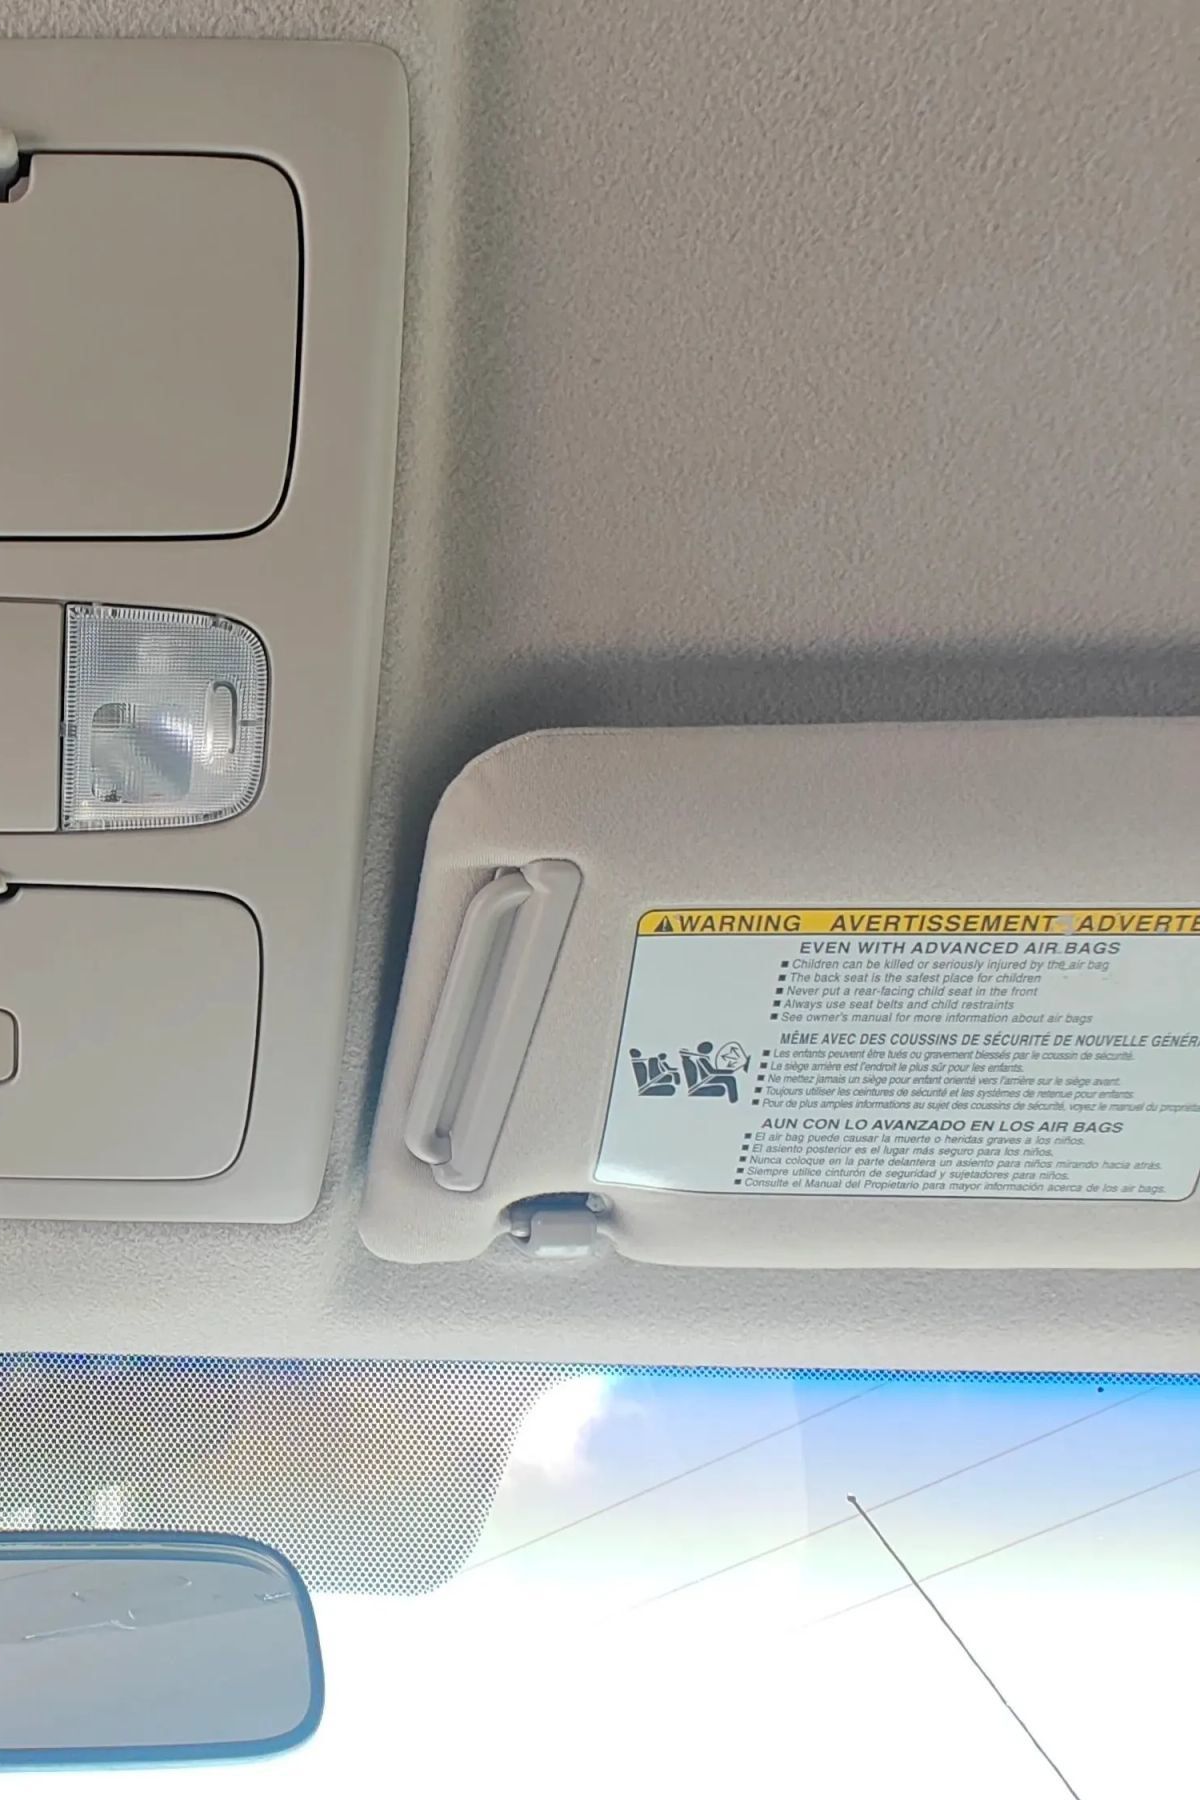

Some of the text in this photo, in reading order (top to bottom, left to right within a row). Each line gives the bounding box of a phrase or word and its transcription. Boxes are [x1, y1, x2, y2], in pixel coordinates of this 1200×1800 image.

[678, 915, 801, 932] WARNING
[830, 914, 1058, 932] AVERTISSEMENT
[800, 942, 1121, 954] EVEN WITH ADVANCED AIR BAGS
[791, 959, 840, 969] Children
[865, 960, 882, 969] be
[883, 960, 915, 969] killed
[931, 960, 985, 971] seriously
[986, 960, 1028, 971] injured
[1028, 960, 1045, 971] by
[1047, 960, 1068, 969] the
[1066, 960, 1085, 969] air
[1086, 960, 1111, 971] bag
[790, 973, 1042, 984] The back seat is the safest place for children
[786, 986, 820, 995] Never
[821, 986, 841, 998] put
[853, 986, 916, 998] rear-facing
[917, 986, 946, 995] child
[947, 987, 973, 995] seat
[975, 987, 987, 996] in
[989, 987, 1009, 996] the
[1011, 987, 1039, 996] front
[783, 1000, 824, 1011] Always
[849, 1000, 874, 1009] seat
[876, 1000, 905, 1009] belts
[907, 1000, 929, 1009] and
[931, 1000, 959, 1009] child
[961, 1000, 1015, 1009] restraints
[781, 1012, 804, 1021] See
[806, 1013, 850, 1021] owner's
[851, 1013, 893, 1022] manual
[895, 1013, 911, 1022] for
[945, 1013, 1009, 1022] information
[1011, 1013, 1045, 1022] about
[1047, 1013, 1063, 1022] air
[1064, 1013, 1094, 1025] bags
[780, 1032, 1200, 1046] MÊME AVEC DES COUSSINS DE SÉCURITÉ DE NOUVELLE GÉNÉR
[770, 1062, 783, 1070] Le
[783, 1062, 810, 1073] siège
[843, 1063, 859, 1071] est
[859, 1063, 897, 1071] l'endroit
[898, 1063, 908, 1071] le
[908, 1063, 930, 1073] plus
[930, 1063, 947, 1071] sûr
[947, 1065, 969, 1074] pour
[987, 1064, 1025, 1072] enfants.
[762, 1119, 1124, 1132] AUN CON LO AVANZADO EN LOS AIR BAGS
[754, 1133, 766, 1141] El
[768, 1133, 783, 1141] air
[784, 1133, 806, 1143] bag
[807, 1134, 841, 1144] puede
[881, 1134, 892, 1142] la
[894, 1135, 932, 1143] muerte
[944, 1135, 985, 1143] heridas
[986, 1138, 1022, 1146] graves
[1035, 1136, 1052, 1144] los
[1054, 1136, 1086, 1144] niños.
[752, 1144, 764, 1152] El
[765, 1144, 804, 1153] asiento
[805, 1145, 852, 1156] posterior
[870, 1146, 881, 1154] el
[882, 1146, 910, 1156] lugar
[912, 1146, 936, 1154] más
[937, 1148, 975, 1157] seguro
[976, 1149, 1001, 1157] para
[1004, 1147, 1021, 1155] los
[1022, 1147, 1054, 1156] niños.
[746, 1168, 1070, 1181] Siempre utilice cinturón de seguridad y sujetadores para niños.
